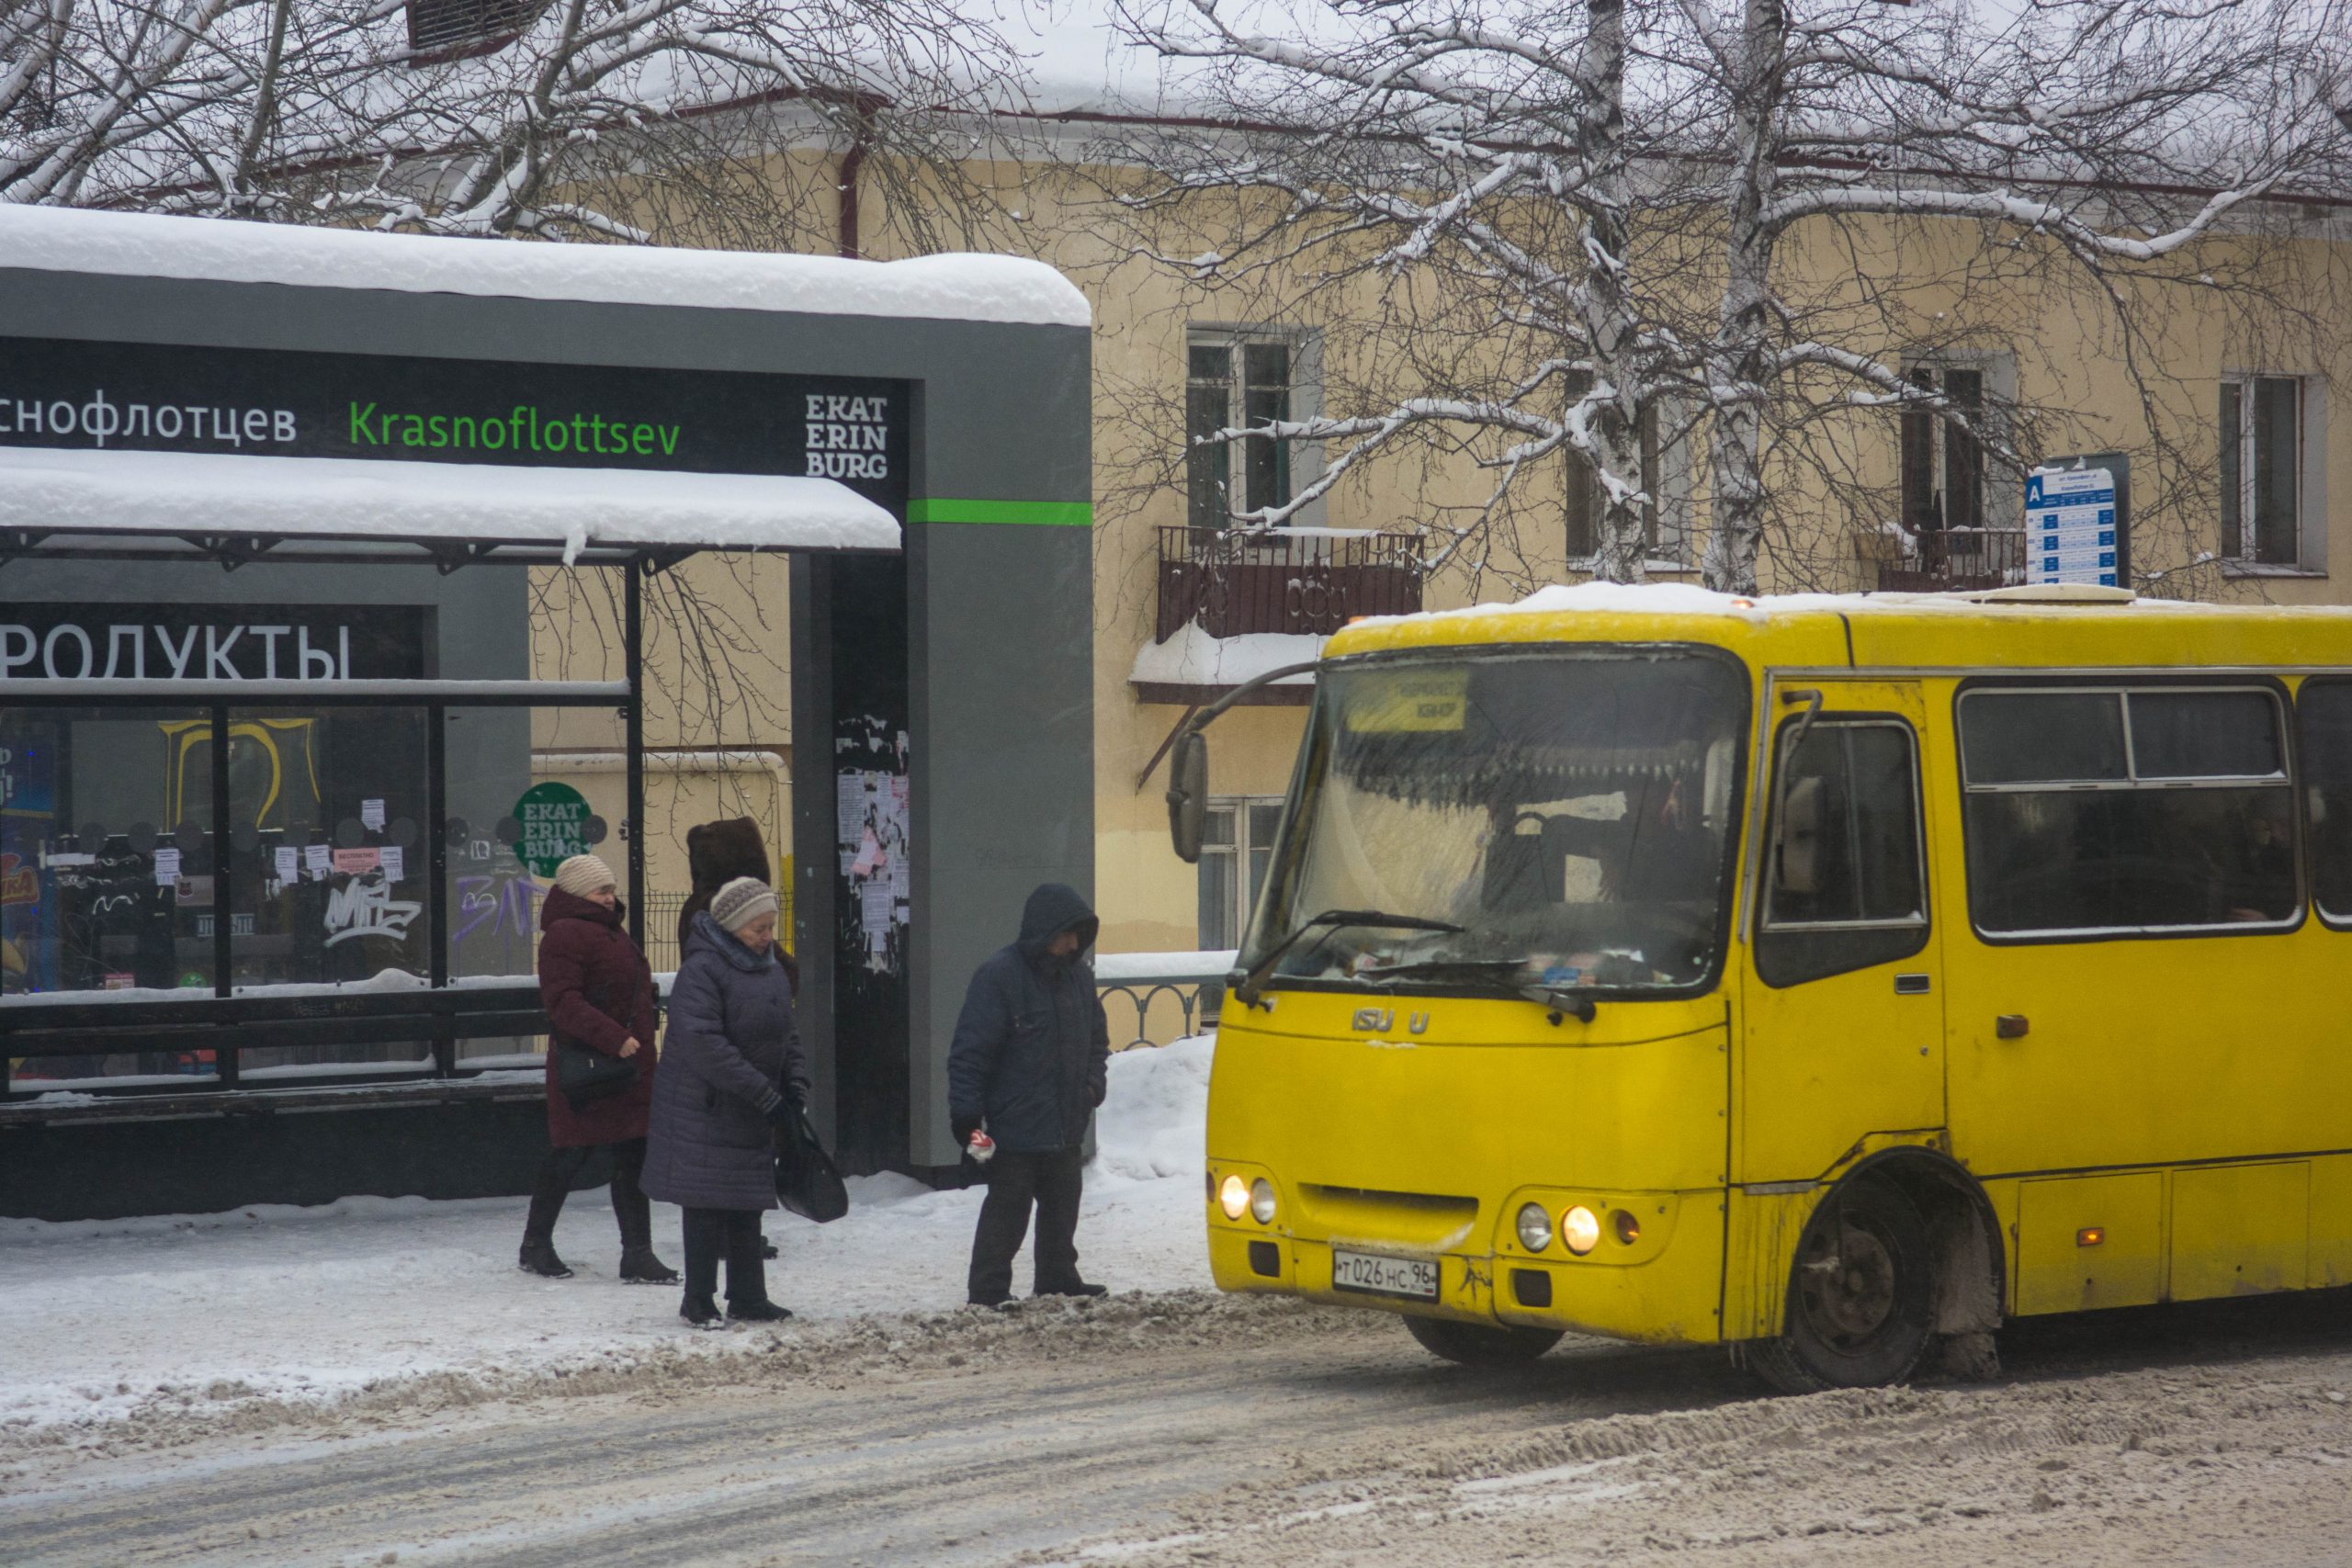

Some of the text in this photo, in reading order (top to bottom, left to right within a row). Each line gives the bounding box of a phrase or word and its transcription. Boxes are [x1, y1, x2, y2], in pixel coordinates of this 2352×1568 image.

[806, 394, 888, 422] EKAT
[350, 401, 681, 456] Krasnoflottsev
[806, 423, 888, 451] ERIN
[806, 451, 888, 479] BURG
[524, 803, 581, 820] EKAT
[524, 821, 581, 840] ERIN
[524, 840, 582, 859] BURG
